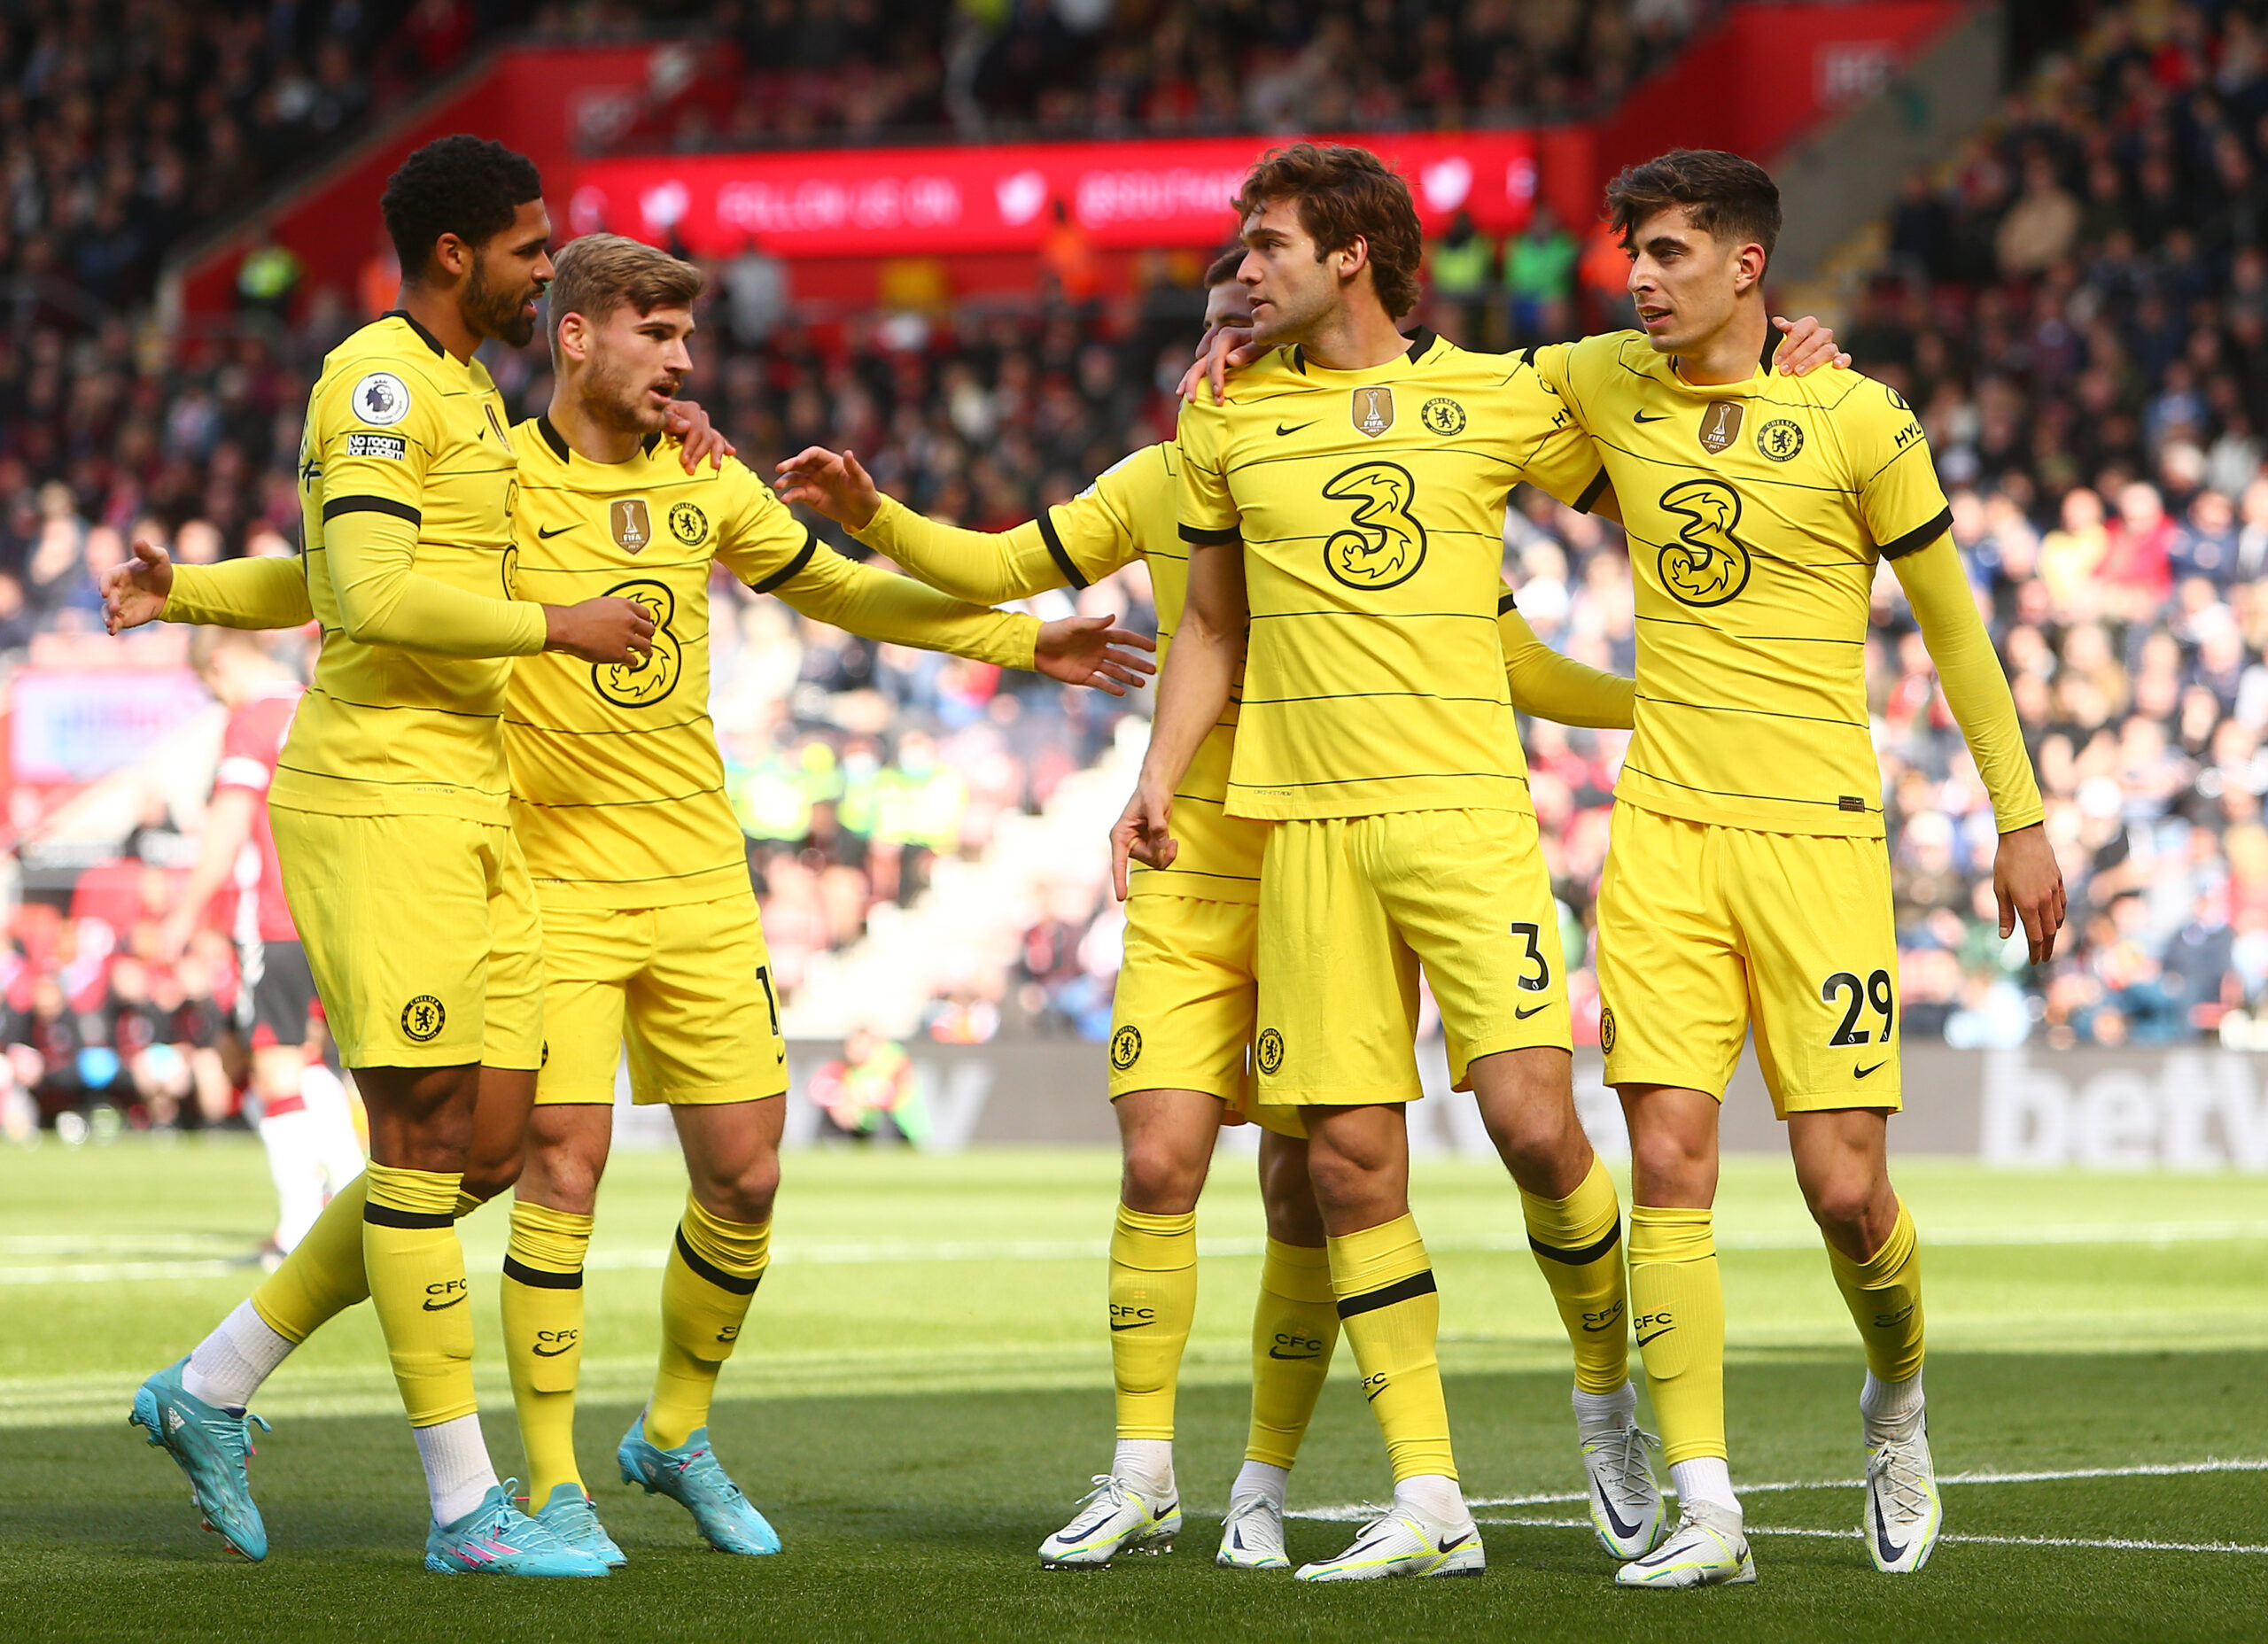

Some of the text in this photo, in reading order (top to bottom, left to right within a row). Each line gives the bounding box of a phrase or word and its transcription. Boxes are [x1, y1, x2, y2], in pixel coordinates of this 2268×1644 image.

[1766, 419, 1798, 431] CHELSEA
[348, 434, 401, 451] No room
[1707, 433, 1727, 444] FIFA
[1511, 922, 1550, 991] 3
[1822, 969, 1893, 1047] 29
[426, 1278, 467, 1295] CFC
[1109, 1305, 1154, 1319] CFC
[1582, 1299, 1623, 1322] CFC
[1634, 1313, 1674, 1330] CFC
[1275, 1333, 1323, 1351] CFC
